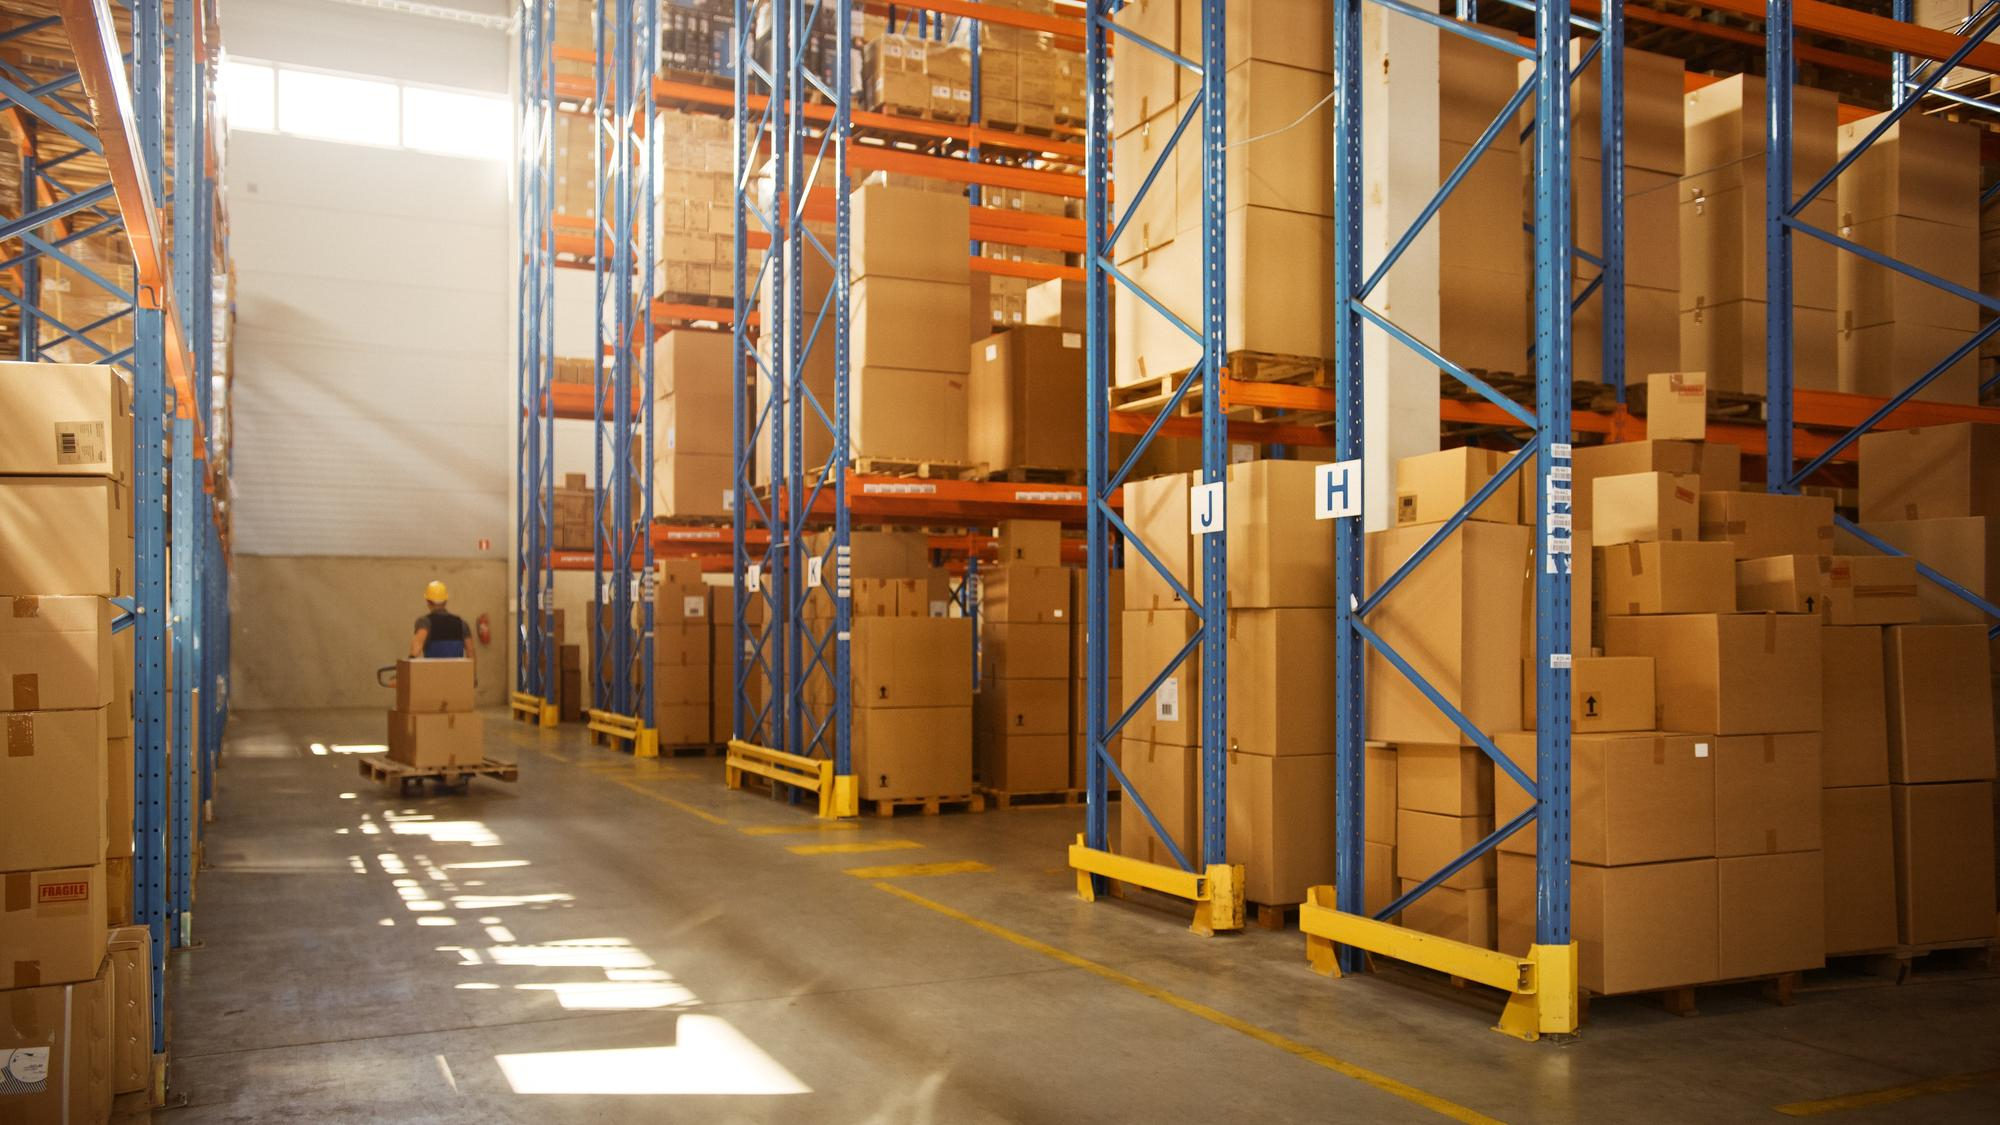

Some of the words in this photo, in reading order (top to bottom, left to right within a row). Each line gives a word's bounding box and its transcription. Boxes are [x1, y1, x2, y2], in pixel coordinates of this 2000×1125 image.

[1327, 469, 1348, 511] H
[1201, 490, 1212, 527] J
[811, 560, 817, 583] K
[42, 885, 85, 897] FRAGILE
